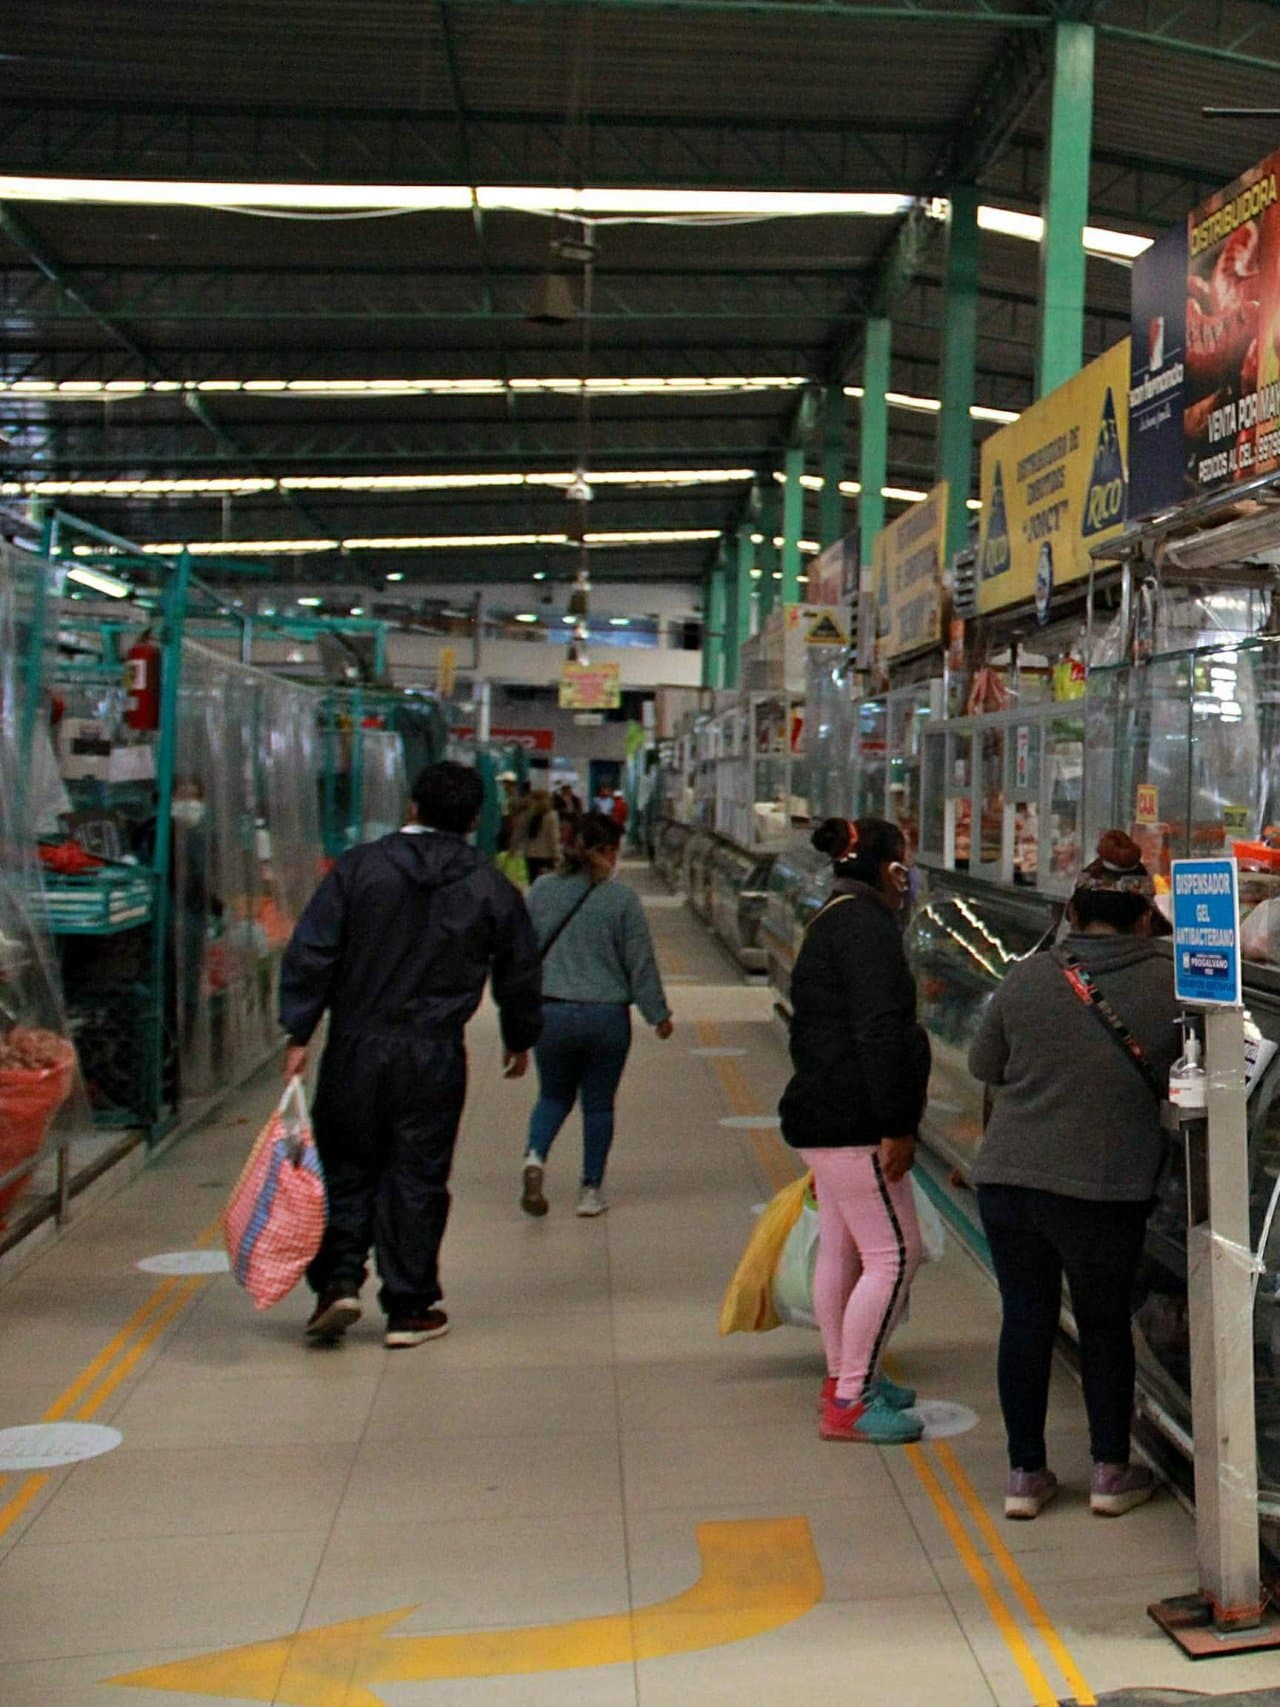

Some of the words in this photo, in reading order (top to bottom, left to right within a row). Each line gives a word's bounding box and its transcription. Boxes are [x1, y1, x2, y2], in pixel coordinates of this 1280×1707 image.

[1190, 173, 1277, 257] DISTRIBUIDORA
[1207, 402, 1237, 443] VENTA
[1237, 392, 1258, 431] POR
[1087, 477, 1123, 529] RICO
[1175, 872, 1231, 896] DISPENSADOR
[1195, 903, 1211, 922] GEL
[1175, 927, 1234, 947] ANTIBACTERIANO
